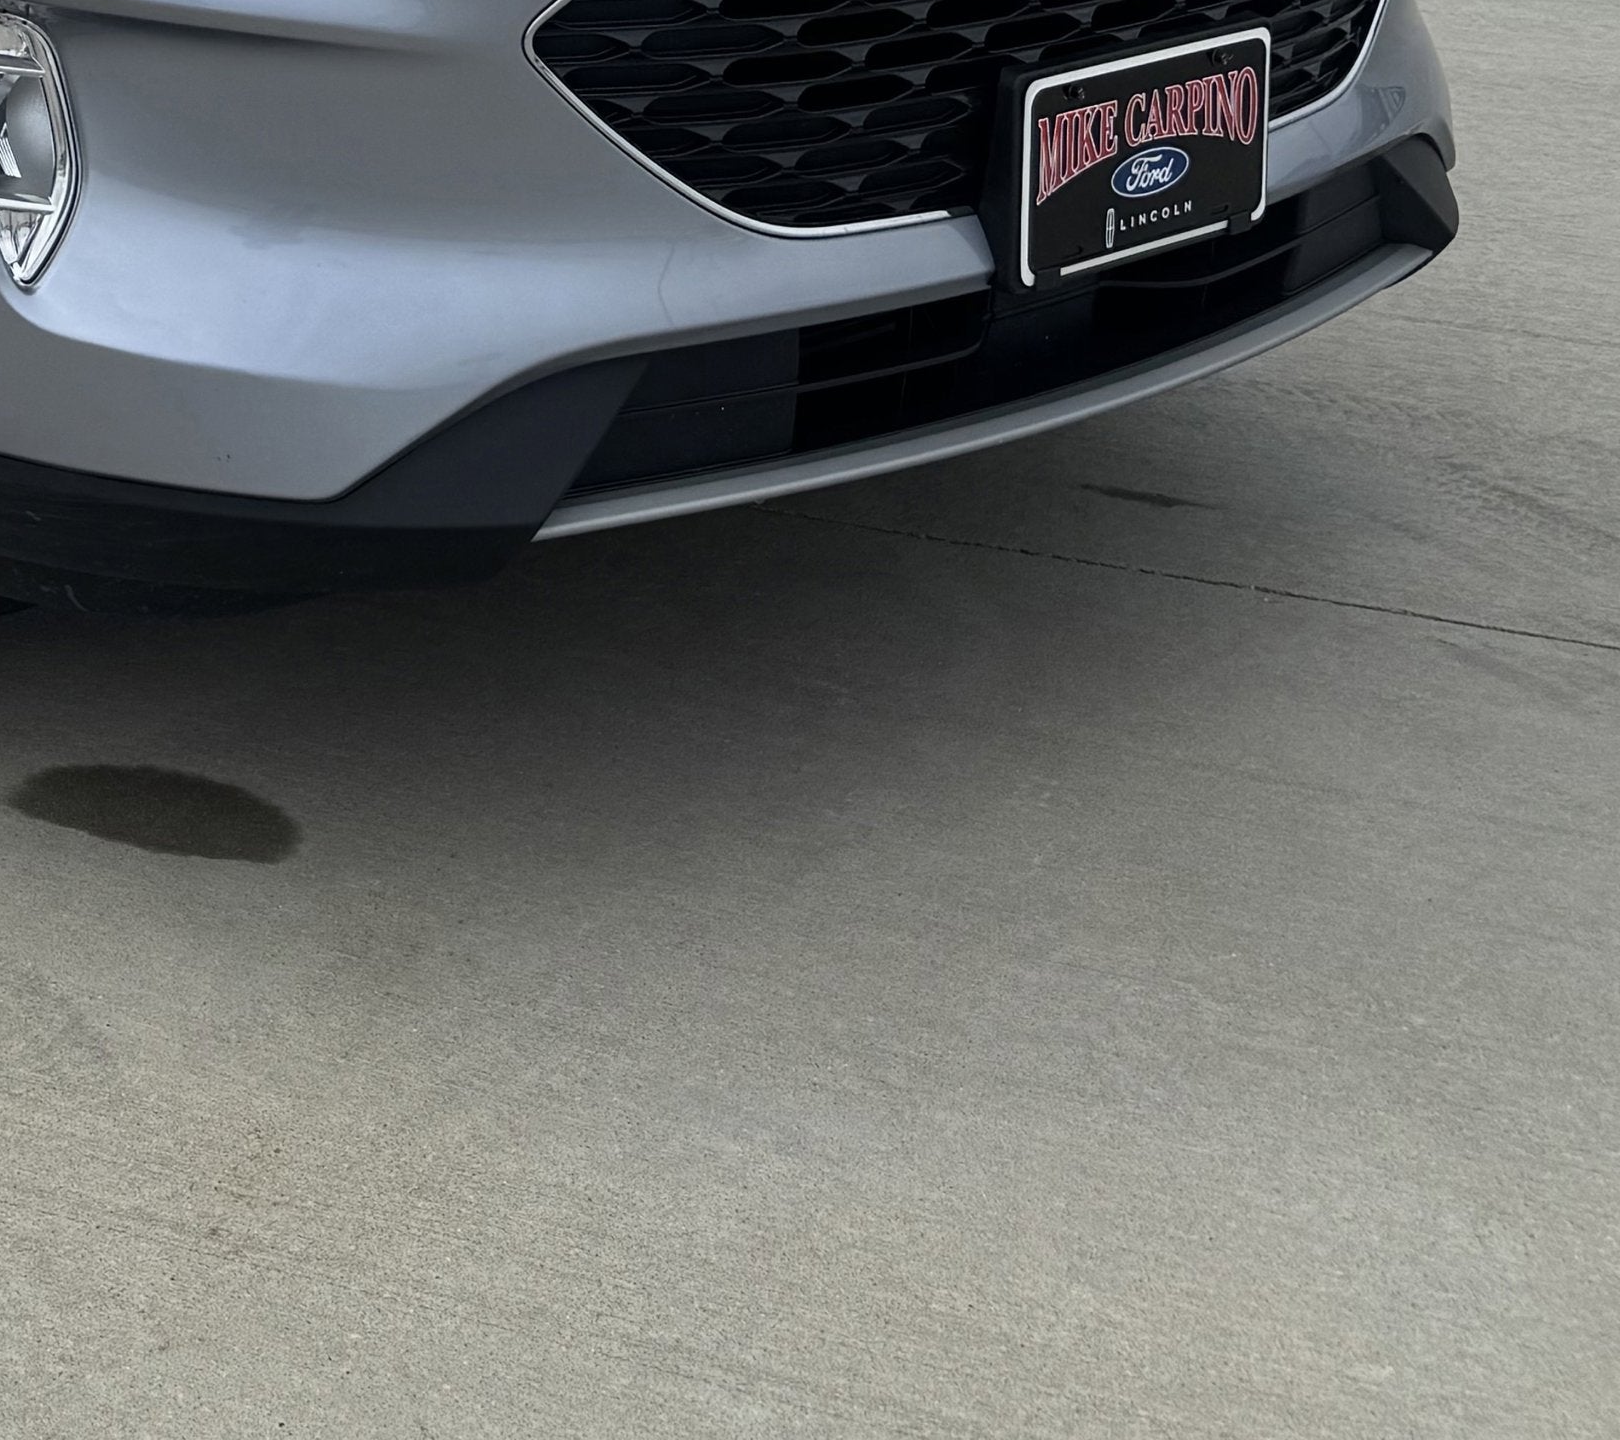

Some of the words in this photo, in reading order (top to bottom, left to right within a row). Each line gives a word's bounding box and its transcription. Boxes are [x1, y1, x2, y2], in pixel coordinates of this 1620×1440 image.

[1036, 99, 1118, 206] MIKE
[1124, 66, 1258, 147] CARPINO
[1125, 154, 1174, 192] Ford
[1119, 200, 1193, 231] LINCOLN
